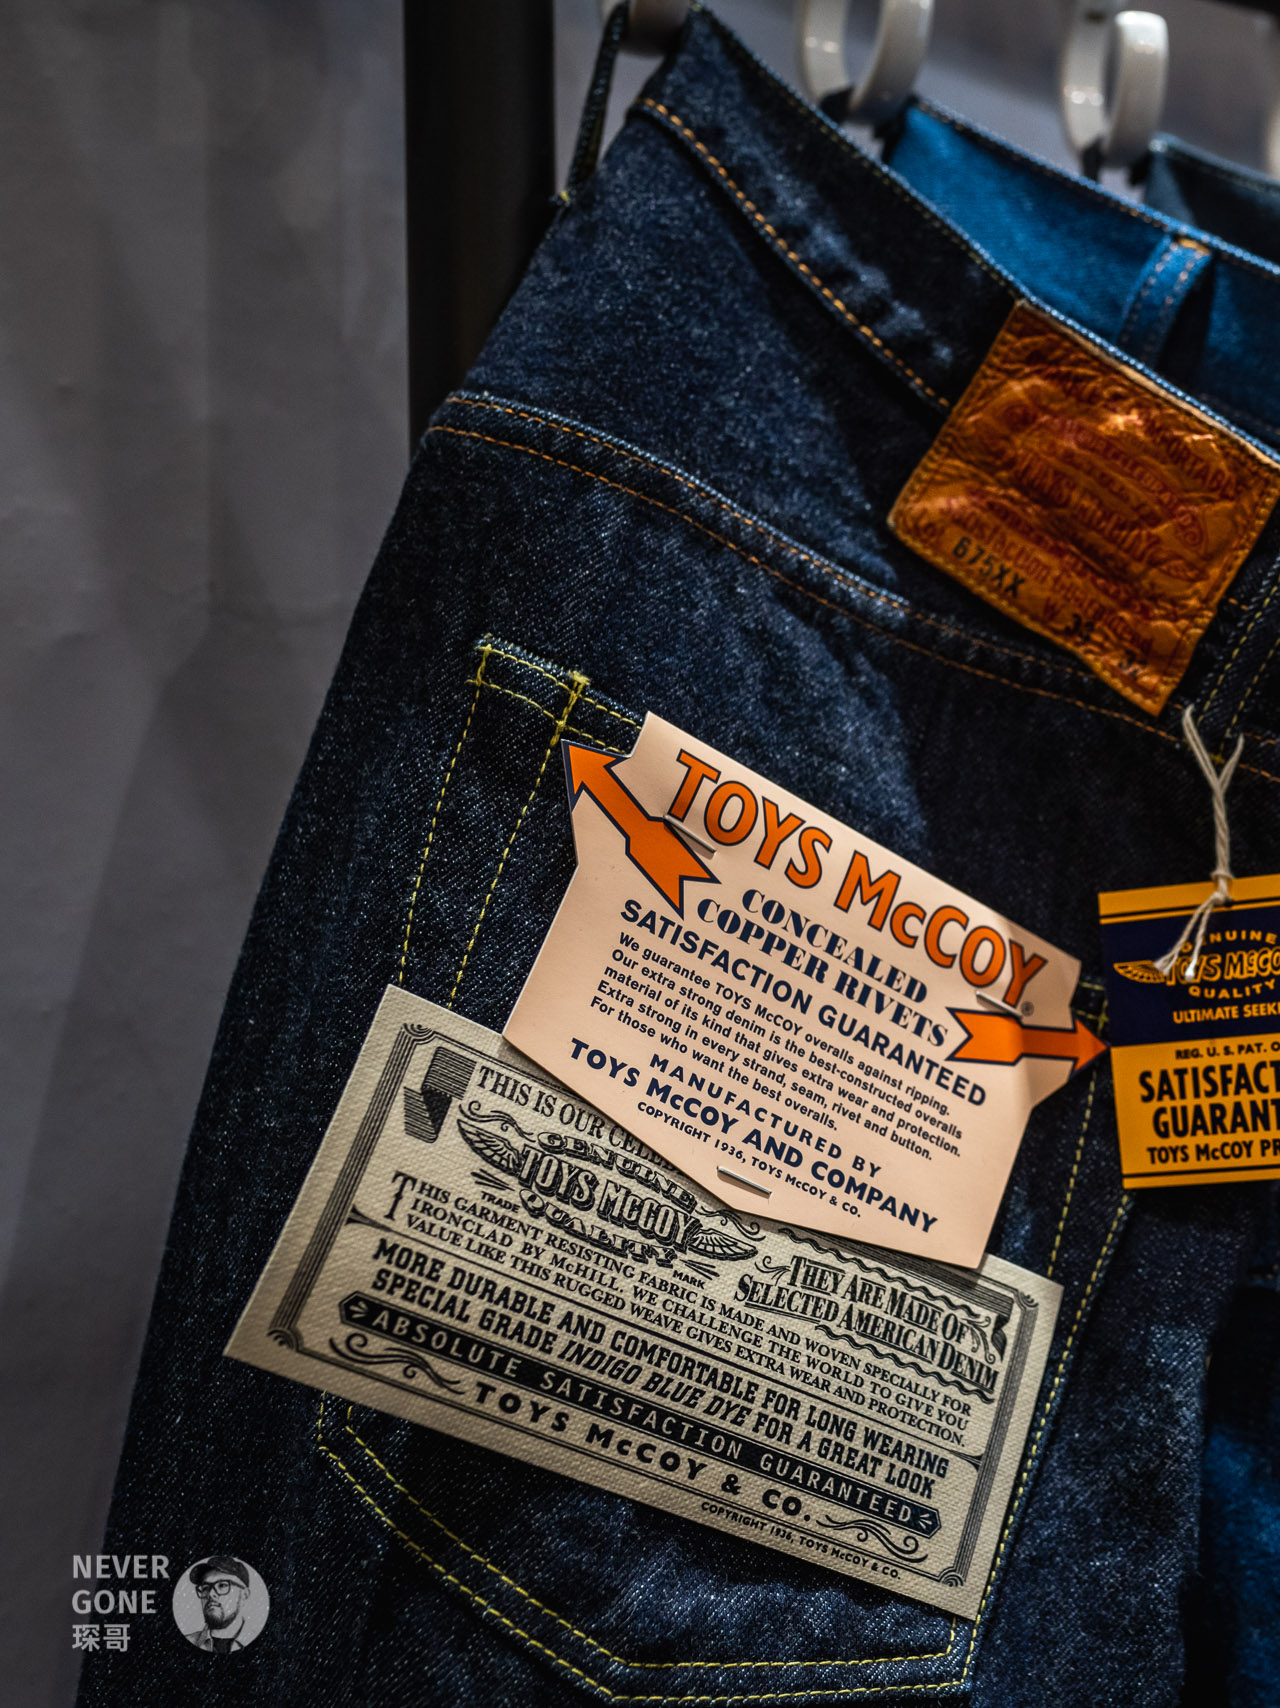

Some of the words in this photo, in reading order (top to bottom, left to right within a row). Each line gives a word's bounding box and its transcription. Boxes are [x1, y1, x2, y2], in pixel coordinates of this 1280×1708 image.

[952, 536, 1025, 599] 675XX
[659, 748, 833, 888] TOYS
[832, 848, 1048, 1010] McCOY
[741, 888, 928, 1004] CONCEALED
[618, 930, 641, 953] We
[640, 947, 712, 990] guarantee
[714, 980, 753, 1011] TOYS
[753, 1002, 804, 1037] McCOY
[803, 1032, 855, 1065] overalls
[856, 1060, 904, 1091] against
[904, 1085, 950, 1117] ripping.
[619, 898, 814, 1016] SATISFACTION
[817, 1003, 987, 1107] GUARANTEED
[696, 897, 830, 985] COPPER
[832, 969, 949, 1048] RIVETS
[1172, 1005, 1240, 1024] ULTIMATE
[1188, 978, 1276, 999] QUALITY
[478, 1065, 533, 1107] THIS
[534, 1086, 559, 1118] IS
[558, 1102, 606, 1140] OUR
[589, 994, 616, 1016] For
[616, 1008, 657, 1038] those
[659, 1031, 689, 1055] who
[691, 1048, 726, 1074] want
[726, 1064, 750, 1086] the
[751, 1076, 783, 1103] best
[783, 1096, 838, 1132] overalls.
[596, 978, 635, 1009] Extra
[636, 1002, 683, 1034] strong
[683, 1023, 699, 1041] in
[700, 1035, 741, 1063] every
[741, 1056, 787, 1089] strand,
[789, 1081, 828, 1110] seam,
[830, 1101, 862, 1125] rivet
[862, 1118, 889, 1138] and
[889, 1129, 933, 1161] button.
[602, 965, 663, 1003] material
[663, 996, 681, 1011] of
[679, 1002, 699, 1022] its
[700, 1013, 733, 1039] kind
[733, 1030, 762, 1055] that
[761, 1048, 799, 1073] gives
[800, 1067, 835, 1092] extra
[837, 1085, 870, 1109] wear
[869, 1103, 896, 1123] and
[895, 1117, 961, 1158] protection.
[610, 948, 640, 970] Our
[640, 965, 677, 991] extra
[677, 985, 723, 1017] strong
[724, 1008, 767, 1038] denim
[768, 1029, 782, 1046] is
[783, 1037, 806, 1059] the
[807, 1049, 914, 1114] best-constructed
[913, 1108, 963, 1140] overalls
[1175, 1047, 1204, 1060] REG.
[1237, 1042, 1267, 1055] PAT.
[537, 1131, 699, 1214] GENUINE
[570, 1036, 641, 1088] TOYS
[644, 1076, 740, 1135] McCOY
[740, 1127, 804, 1169] AND
[809, 1159, 939, 1234] COMPANY
[636, 1100, 712, 1143] COPYRIGHT
[713, 1137, 747, 1164] 1936,
[750, 1155, 783, 1179] TOYS
[783, 1172, 828, 1200] McCOY
[840, 1200, 862, 1219] CO.
[648, 1052, 843, 1160] MANUFACTURED
[850, 1153, 882, 1179] BY
[1147, 1144, 1190, 1165] TOYS
[1195, 1139, 1254, 1162] McCOY
[480, 1190, 521, 1213] TRADE
[518, 1188, 680, 1268] QUALITY
[672, 1269, 706, 1291] MARK
[518, 1143, 600, 1212] TOYS
[598, 1178, 702, 1251] McCOY
[371, 1237, 447, 1284] MORE
[445, 1265, 557, 1326] DURABLE
[555, 1309, 607, 1345] AND
[608, 1328, 761, 1405] COMFORTABLE
[759, 1386, 802, 1422] FOR
[803, 1403, 859, 1444] LONG
[861, 1425, 950, 1480] WEARING
[406, 1212, 465, 1248] VALUE
[463, 1236, 507, 1265] LIKE
[509, 1253, 553, 1282] THIS
[551, 1271, 627, 1311] RUGGED
[629, 1300, 684, 1335] WEAVE
[684, 1324, 734, 1354] GIVES
[733, 1343, 786, 1376] EXTRA
[788, 1364, 832, 1394] WEAR
[831, 1384, 867, 1406] AND
[866, 1396, 966, 1448] PROTECTION.
[409, 1197, 514, 1248] IRONCLAD
[518, 1240, 547, 1261] BY
[547, 1252, 624, 1294] McHILL.
[631, 1283, 660, 1307] WE
[660, 1297, 764, 1349] CHALLENGE
[766, 1338, 803, 1365] THE
[804, 1353, 865, 1389] WORLD
[869, 1379, 893, 1400] TO
[893, 1391, 935, 1418] GIVE
[935, 1407, 970, 1432] YOU
[453, 1196, 545, 1242] GARMENT
[543, 1231, 636, 1280] RESISTING
[636, 1269, 699, 1305] FABRIC
[698, 1294, 718, 1312] IS
[716, 1301, 766, 1333] MADE
[764, 1323, 802, 1346] AND
[804, 1336, 863, 1371] WOVEN
[861, 1361, 941, 1404] SPECIALLY
[940, 1393, 972, 1418] FOR
[734, 1273, 838, 1327] SELECTED
[836, 1304, 940, 1363] AMERICAN
[938, 1340, 999, 1391] DENIM
[787, 1254, 845, 1296] THEY
[846, 1276, 884, 1307] ARE
[882, 1283, 945, 1330] MADE
[940, 1308, 969, 1343] OF
[370, 1267, 472, 1324] SPECIAL
[477, 1307, 559, 1356] GRADE
[556, 1338, 644, 1386] INDIGO
[639, 1370, 707, 1410] BLUE
[701, 1393, 754, 1428] DYE
[750, 1410, 794, 1446] FOR
[795, 1429, 813, 1454] A
[815, 1436, 884, 1479] GREAT
[883, 1461, 937, 1500] LOOK
[371, 1309, 523, 1378] ABSOLUTE
[539, 1370, 743, 1460] SATISFACTION
[758, 1452, 912, 1523] GUARANTEED
[475, 1380, 570, 1433] TOYS
[584, 1421, 709, 1481] McCOY
[719, 1472, 743, 1497] &
[760, 1487, 812, 1523] CO.
